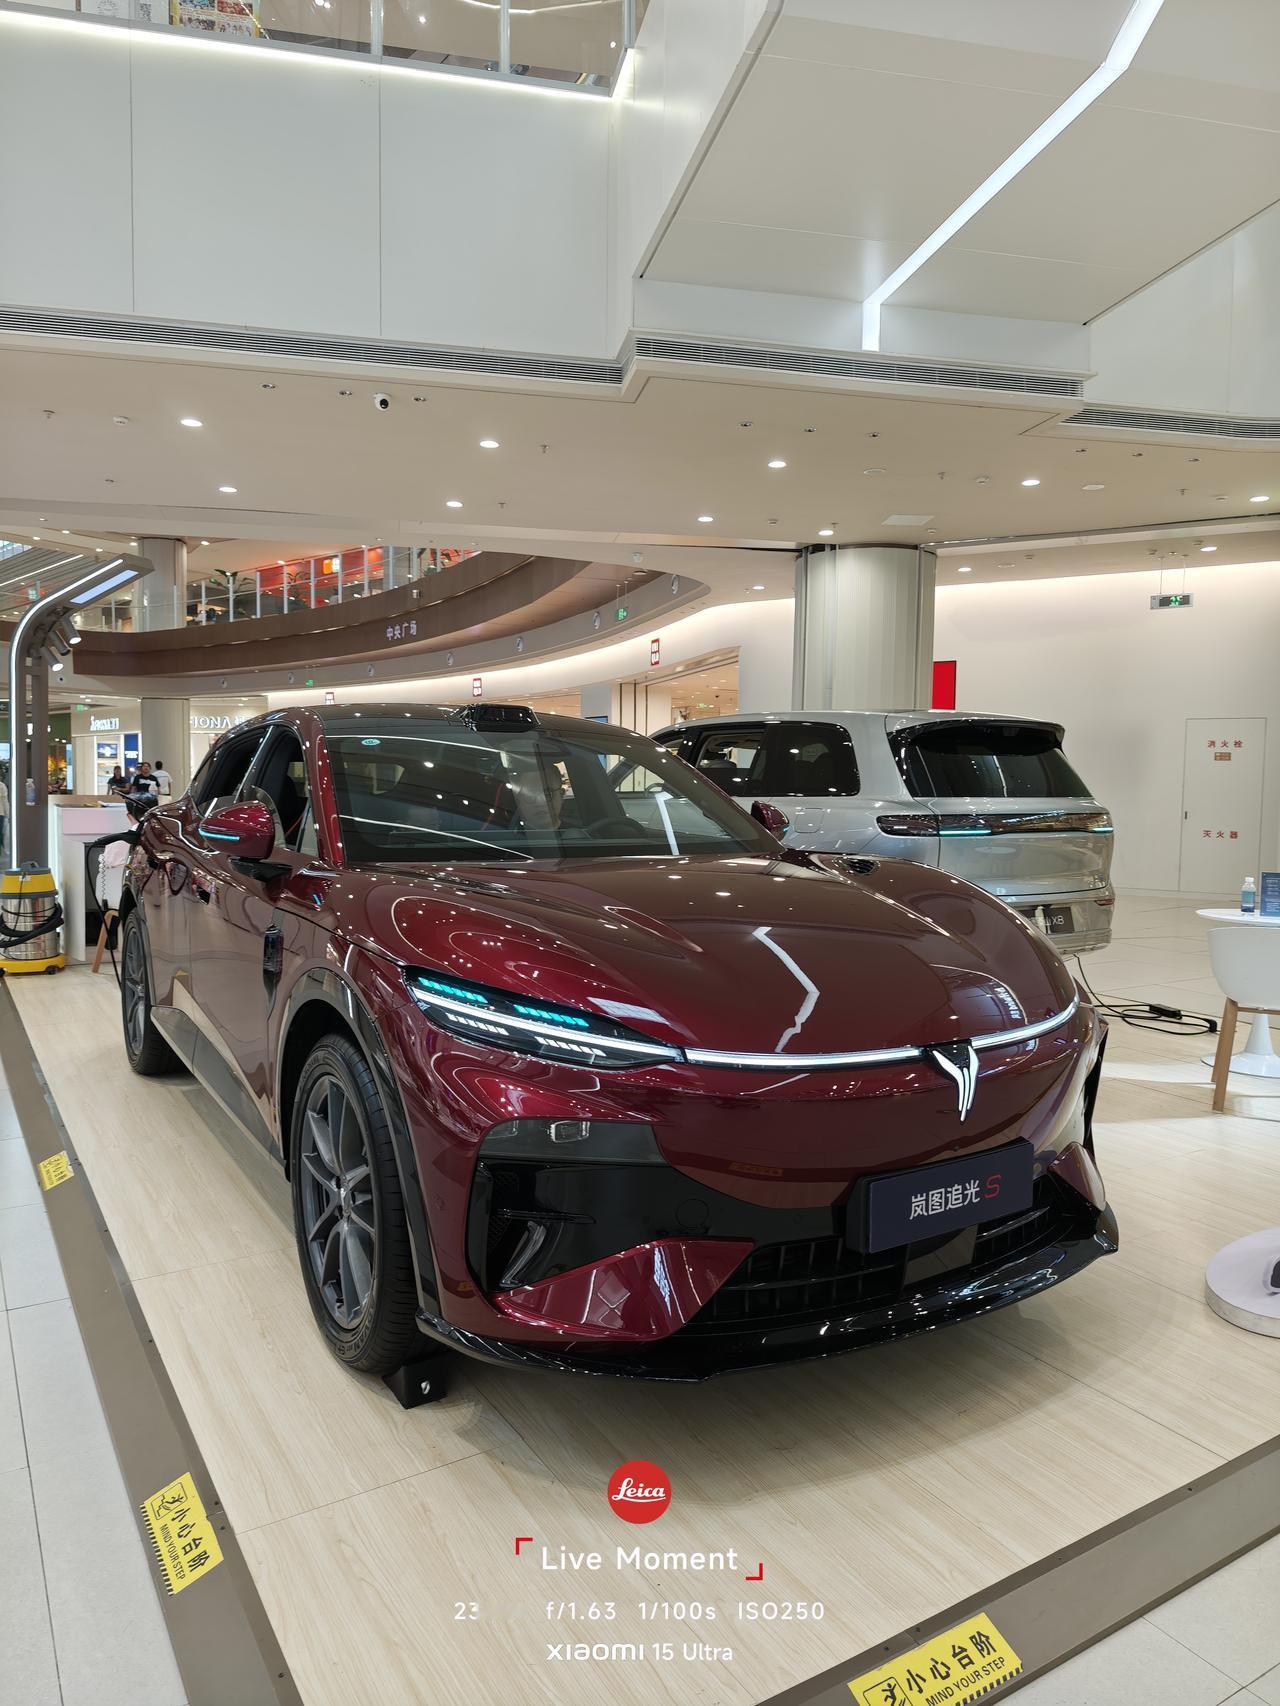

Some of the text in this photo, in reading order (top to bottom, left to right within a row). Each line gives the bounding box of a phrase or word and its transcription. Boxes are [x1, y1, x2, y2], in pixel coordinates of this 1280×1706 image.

[386, 620, 417, 641] 中央广场
[190, 715, 232, 729] IONA
[1207, 740, 1243, 749] 消火栓
[1202, 829, 1239, 840] 灭火器
[909, 1174, 1002, 1221] 岚图追光 S
[160, 1523, 186, 1581] MIND YOUR STEP
[171, 1507, 211, 1573] 小心台阶
[906, 1630, 997, 1695] 小心台阶
[925, 1656, 1006, 1706] MIND YOUR STEP
